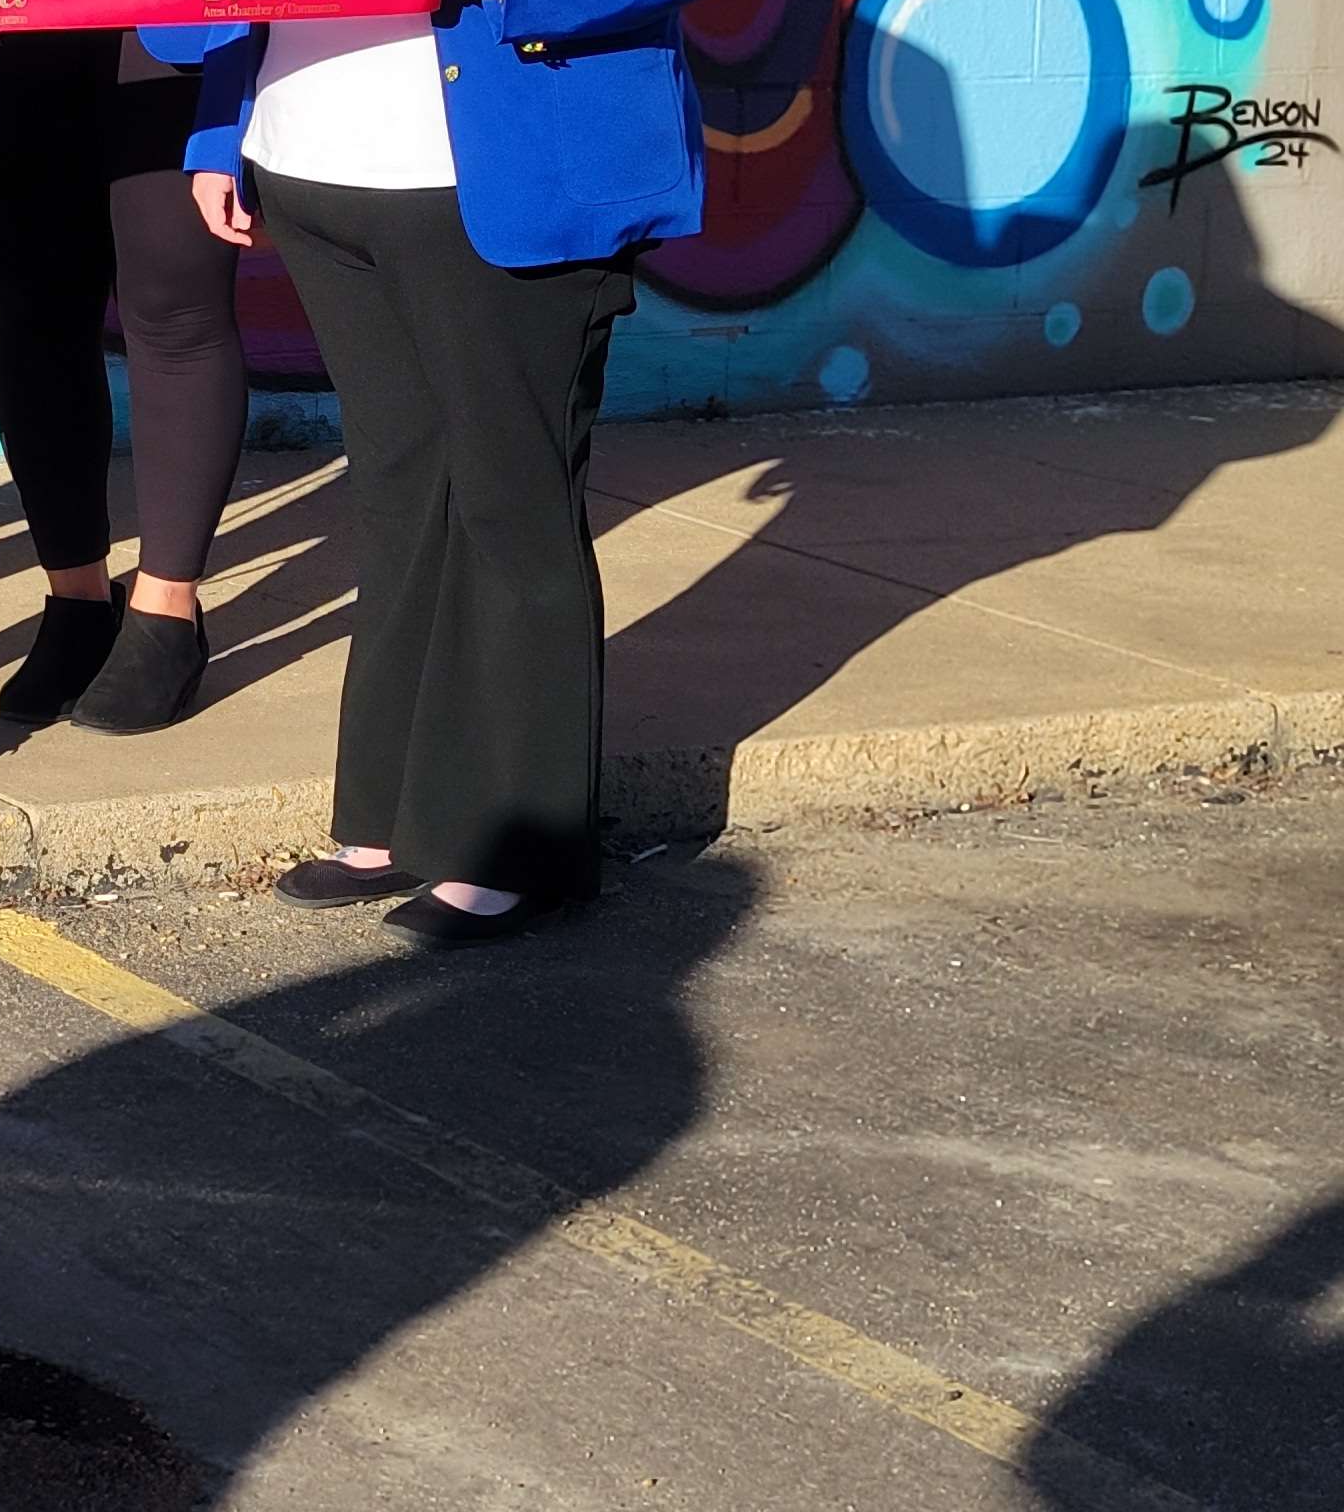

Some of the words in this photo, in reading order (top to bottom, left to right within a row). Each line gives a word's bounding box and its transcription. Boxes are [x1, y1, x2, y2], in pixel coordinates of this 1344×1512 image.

[203, 6, 226, 18] Area
[227, 3, 273, 17] Chamber
[274, 2, 288, 17] of
[1254, 140, 1310, 169] 24
